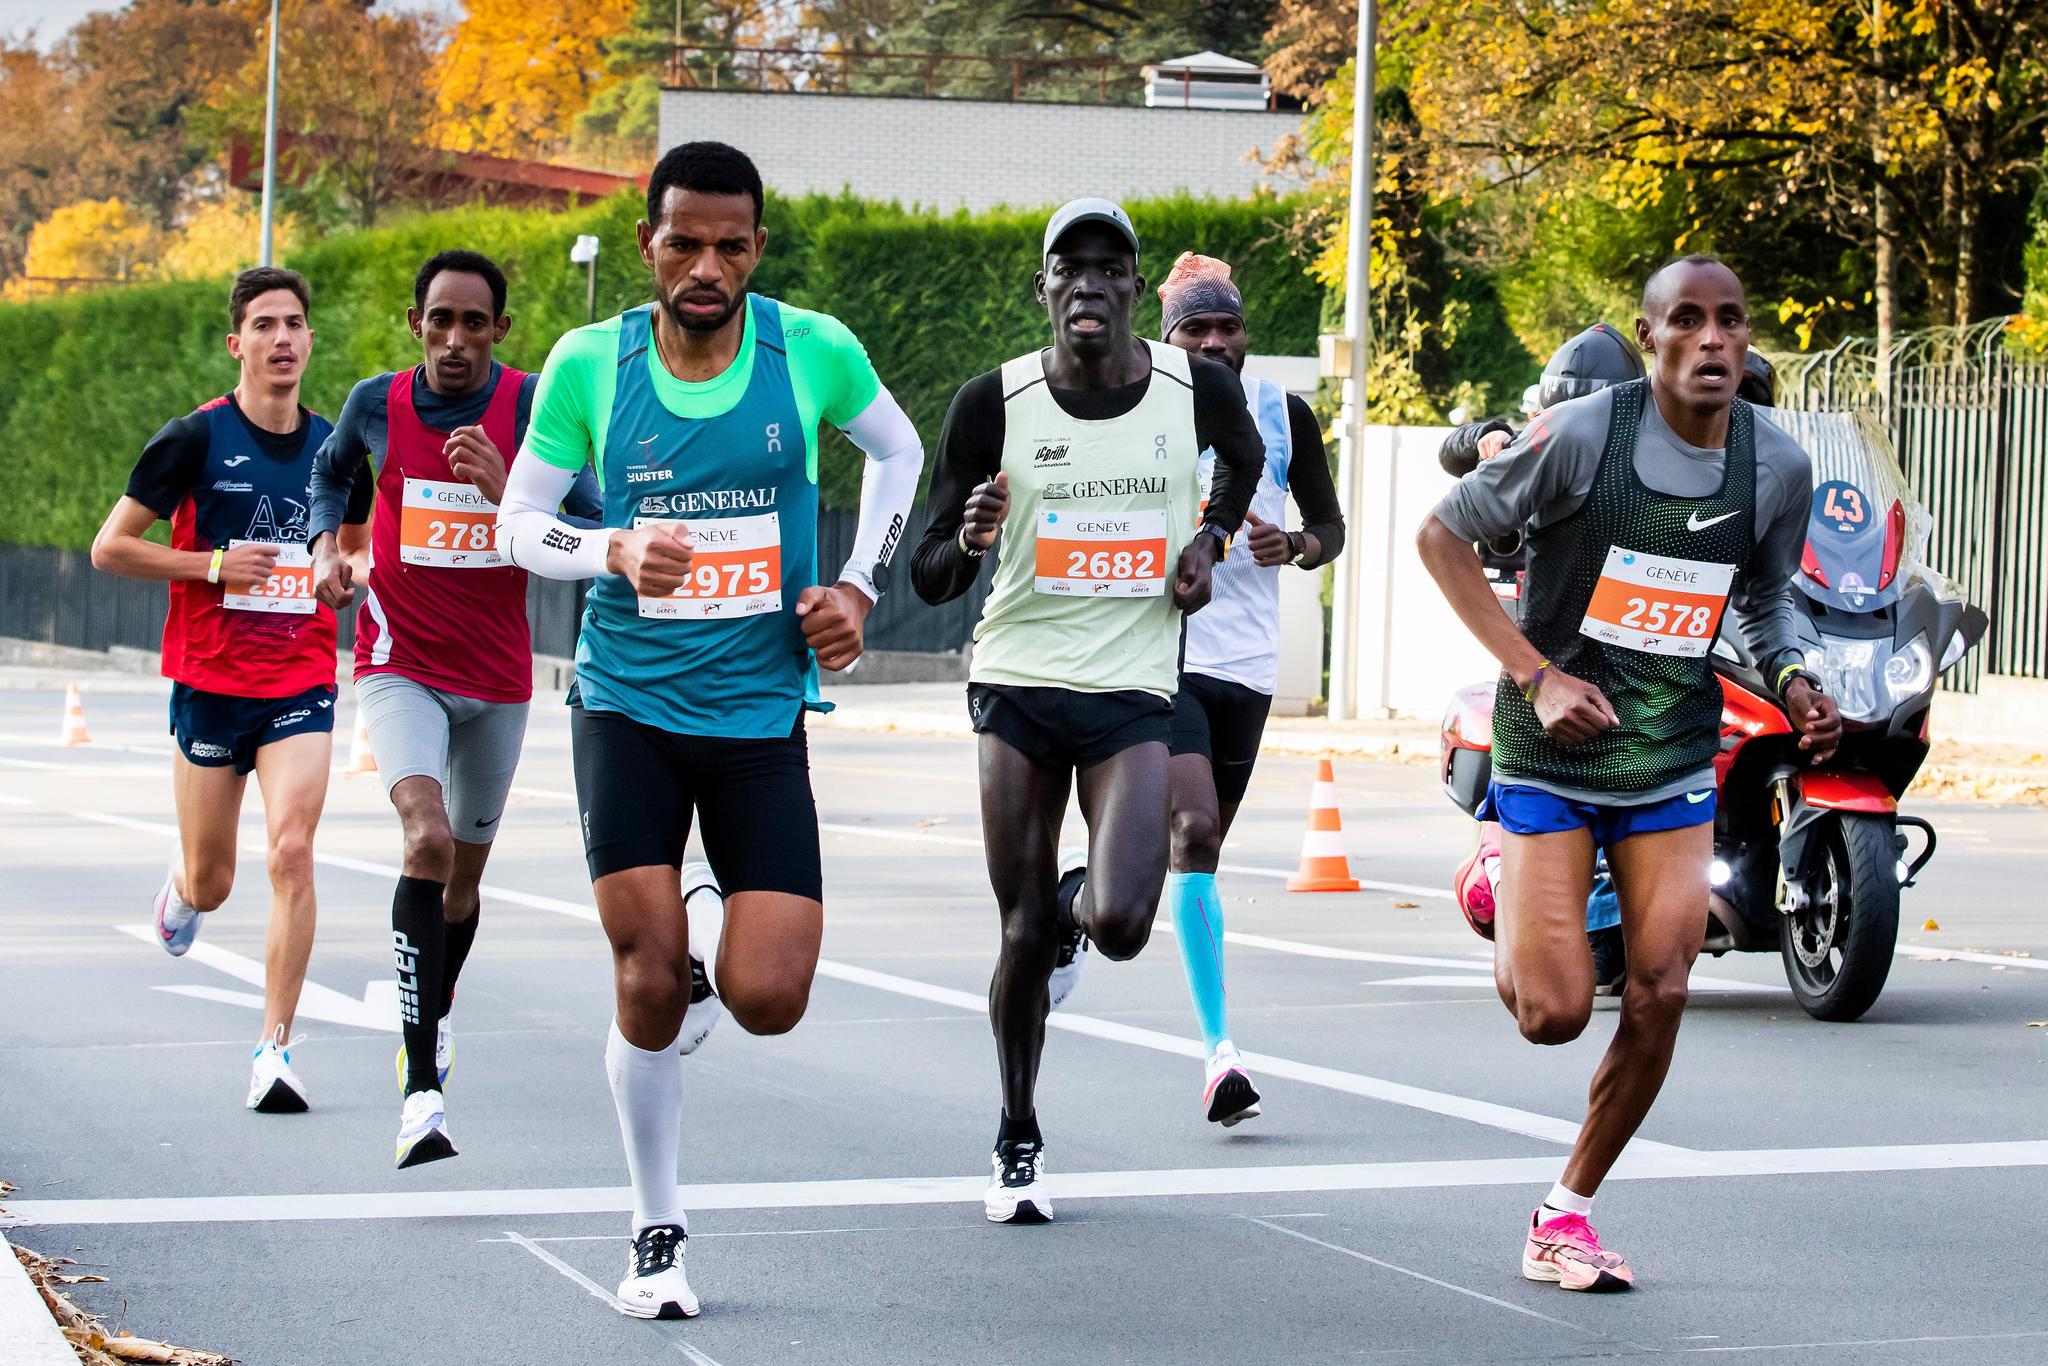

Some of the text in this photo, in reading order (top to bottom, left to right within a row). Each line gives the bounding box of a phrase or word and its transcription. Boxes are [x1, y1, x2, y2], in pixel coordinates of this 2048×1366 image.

[785, 327, 811, 339] cep
[671, 486, 778, 513] GENERALI
[1072, 477, 1168, 499] GENERALI
[1824, 488, 1864, 523] 43
[427, 520, 497, 550] 278
[557, 534, 582, 554] cep
[885, 513, 903, 550] cep
[1066, 550, 1154, 579] 2682
[1621, 598, 1711, 637] 2578
[392, 929, 420, 991] cep
